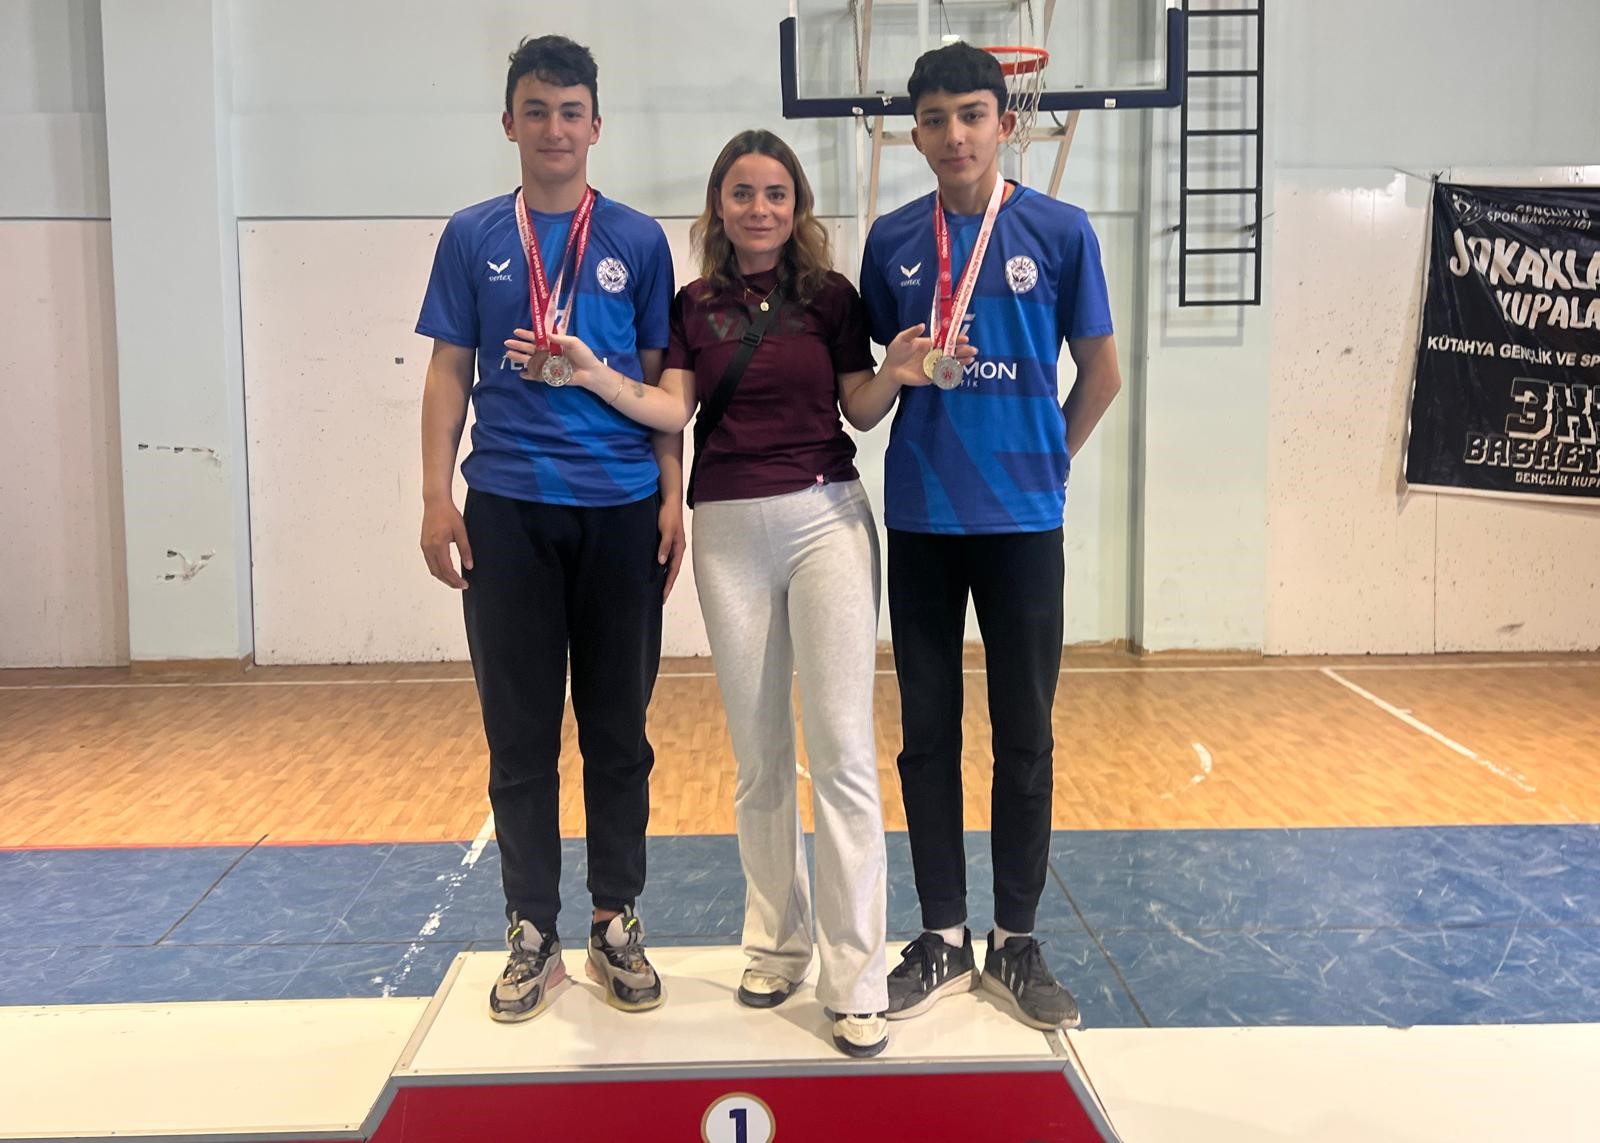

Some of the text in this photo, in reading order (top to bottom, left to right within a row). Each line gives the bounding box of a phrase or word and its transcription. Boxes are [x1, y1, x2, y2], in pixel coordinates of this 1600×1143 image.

[1486, 210, 1518, 223] SPOR
[1573, 209, 1590, 219] VE
[1427, 334, 1495, 357] KÜTAHYA
[1499, 343, 1552, 365] GENÇLİK
[1556, 351, 1577, 367] VE
[729, 1108, 747, 1143] 1
